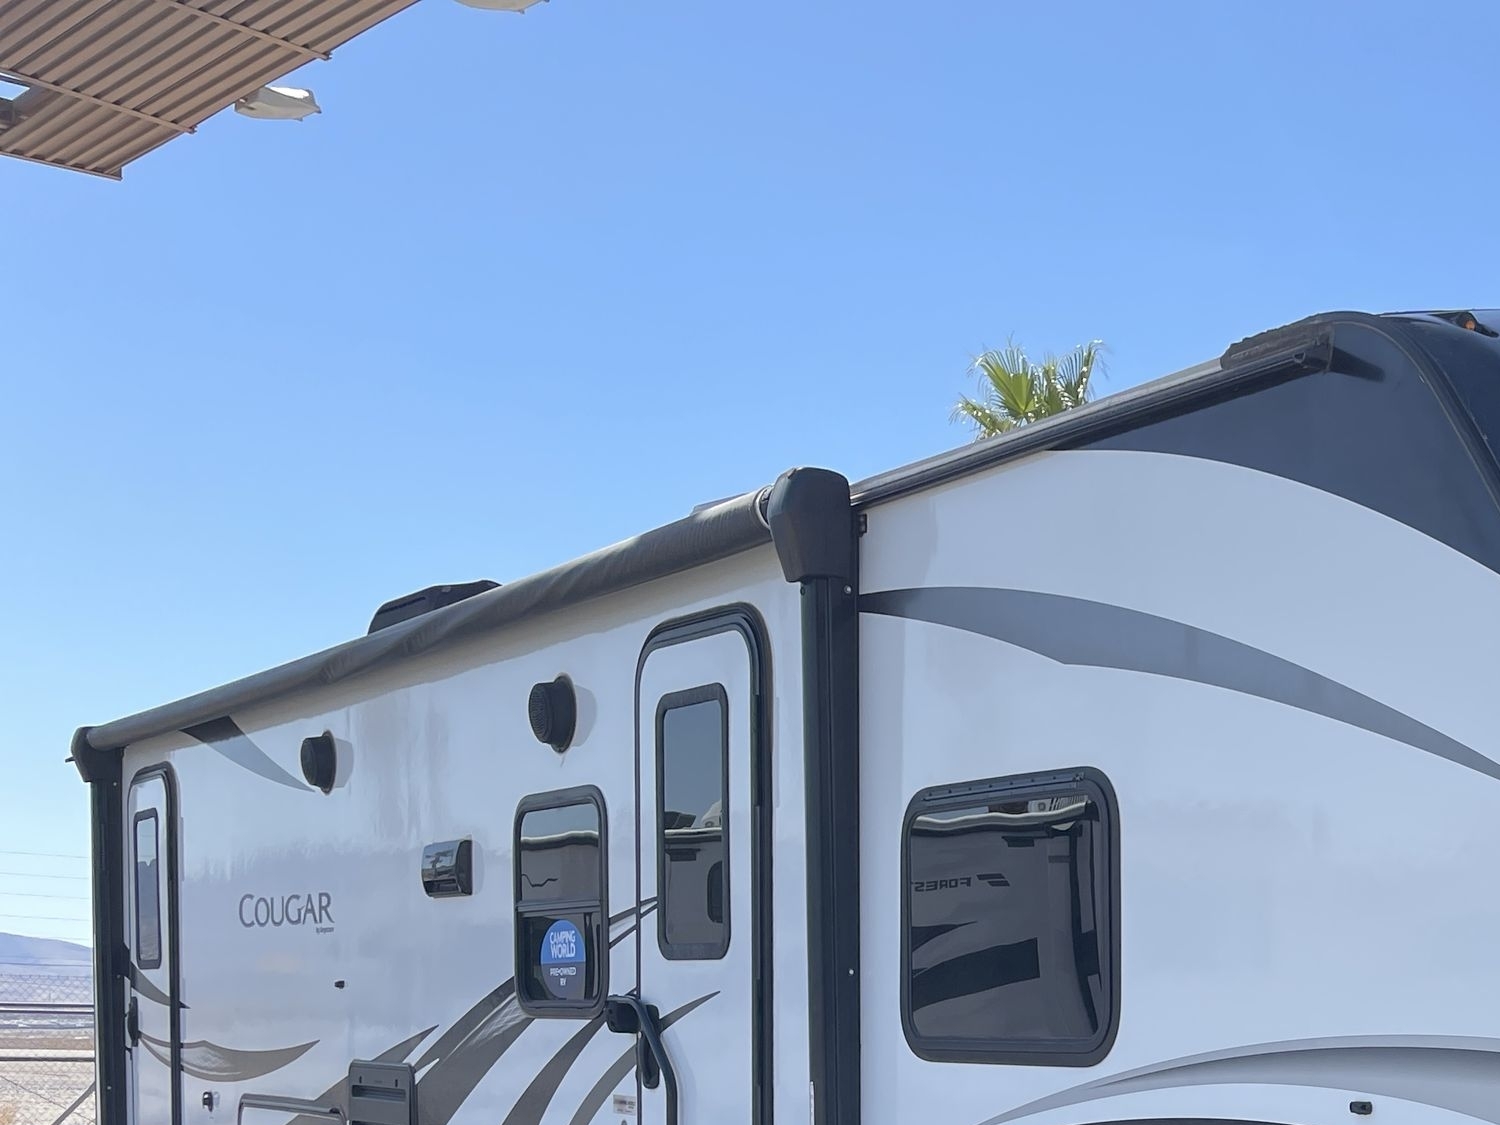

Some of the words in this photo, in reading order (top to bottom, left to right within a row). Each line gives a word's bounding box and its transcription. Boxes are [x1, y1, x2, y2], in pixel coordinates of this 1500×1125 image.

[239, 892, 335, 928] COUGAR
[549, 930, 576, 944] CAMPING
[550, 942, 576, 959] WORLD
[549, 966, 577, 977] PRE-OWNED
